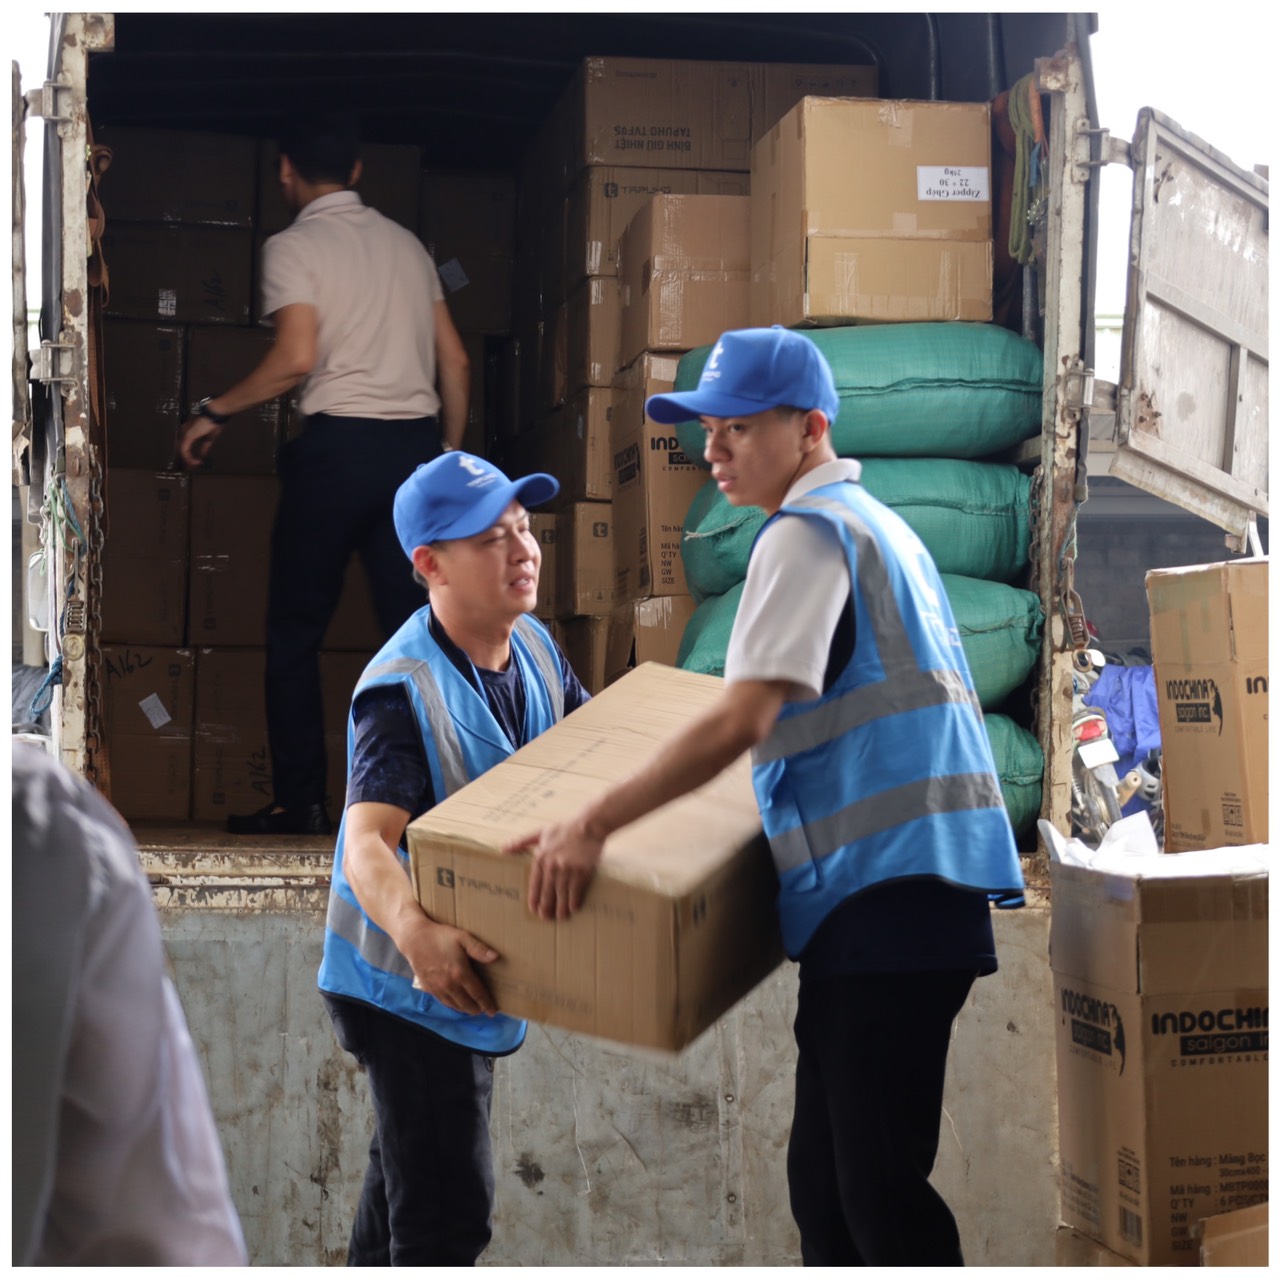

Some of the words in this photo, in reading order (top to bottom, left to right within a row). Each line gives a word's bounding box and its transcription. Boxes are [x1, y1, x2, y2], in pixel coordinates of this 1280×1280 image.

[613, 125, 647, 136] TVF95
[649, 126, 692, 138] TAPUHO
[944, 168, 961, 177] 25kg
[939, 178, 950, 187] 30
[959, 179, 970, 187] 22
[926, 187, 950, 198] Ghép
[951, 187, 981, 198] Zipper
[661, 577, 675, 585] SIZE
[1165, 678, 1209, 701] INDOCHINA
[1186, 1033, 1250, 1052] saigon
